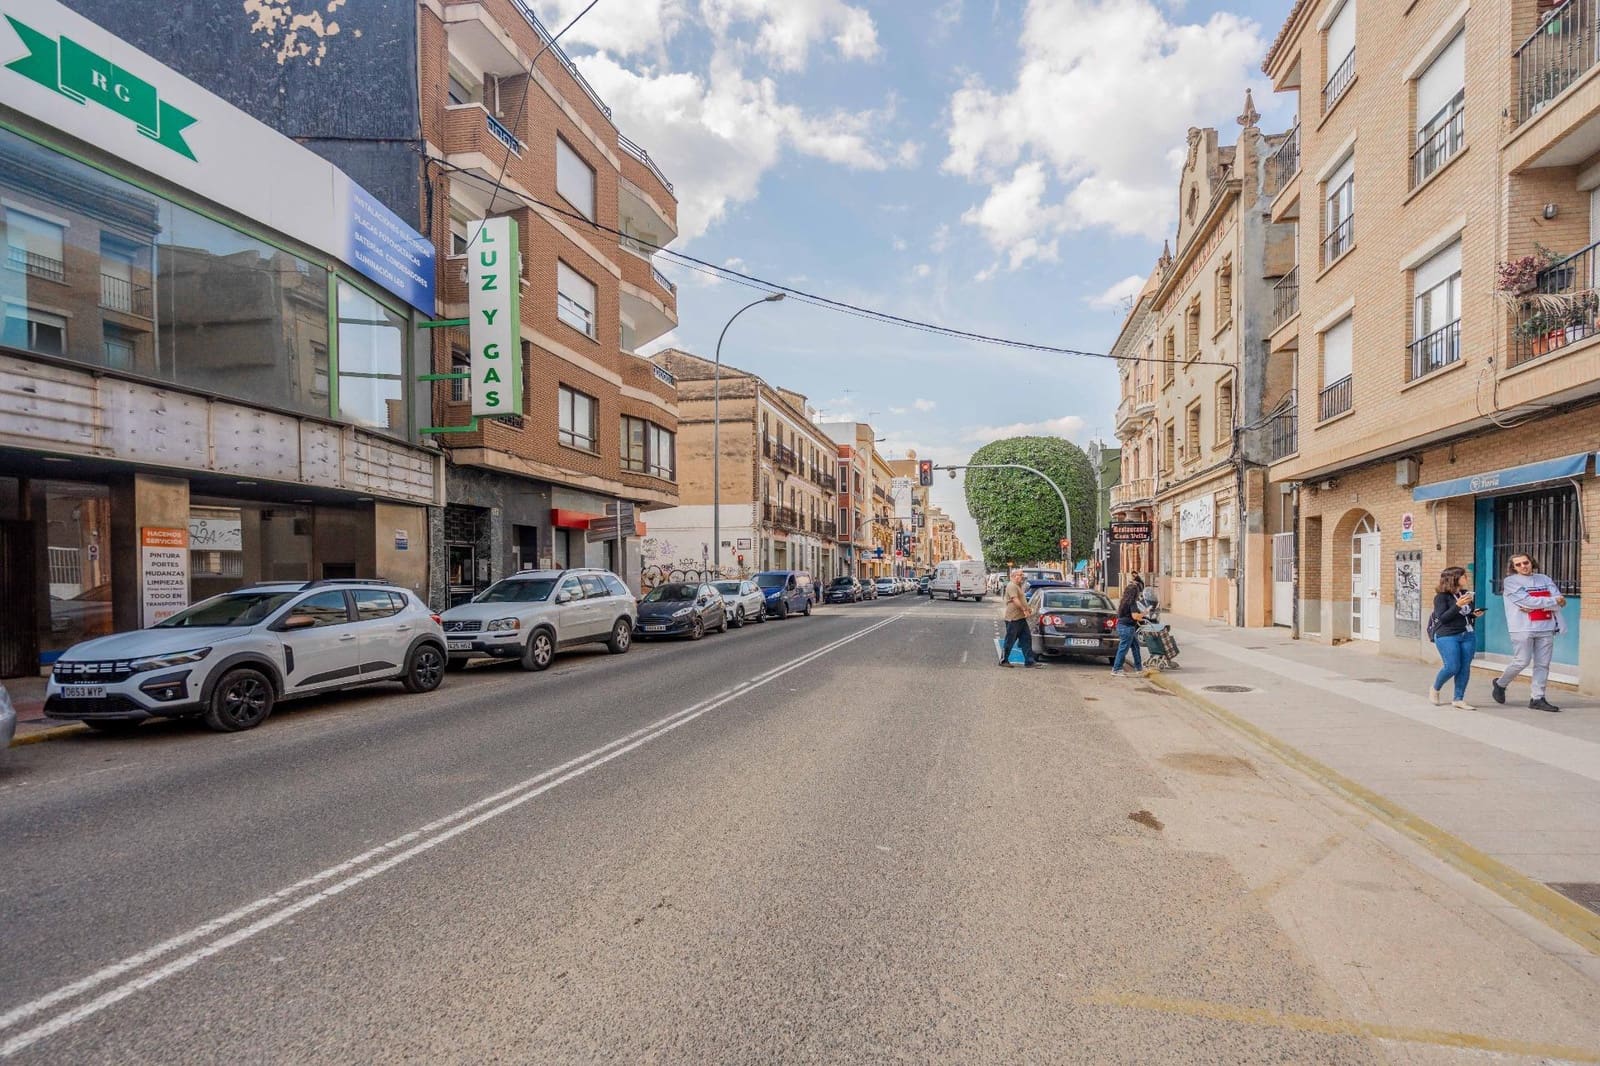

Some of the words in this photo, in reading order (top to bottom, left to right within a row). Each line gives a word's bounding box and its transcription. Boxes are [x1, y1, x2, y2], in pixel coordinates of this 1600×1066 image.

[481, 227, 498, 291] LUZ
[482, 309, 498, 325] Y
[483, 343, 501, 407] GAS
[146, 537, 183, 545] SERVICIOS
